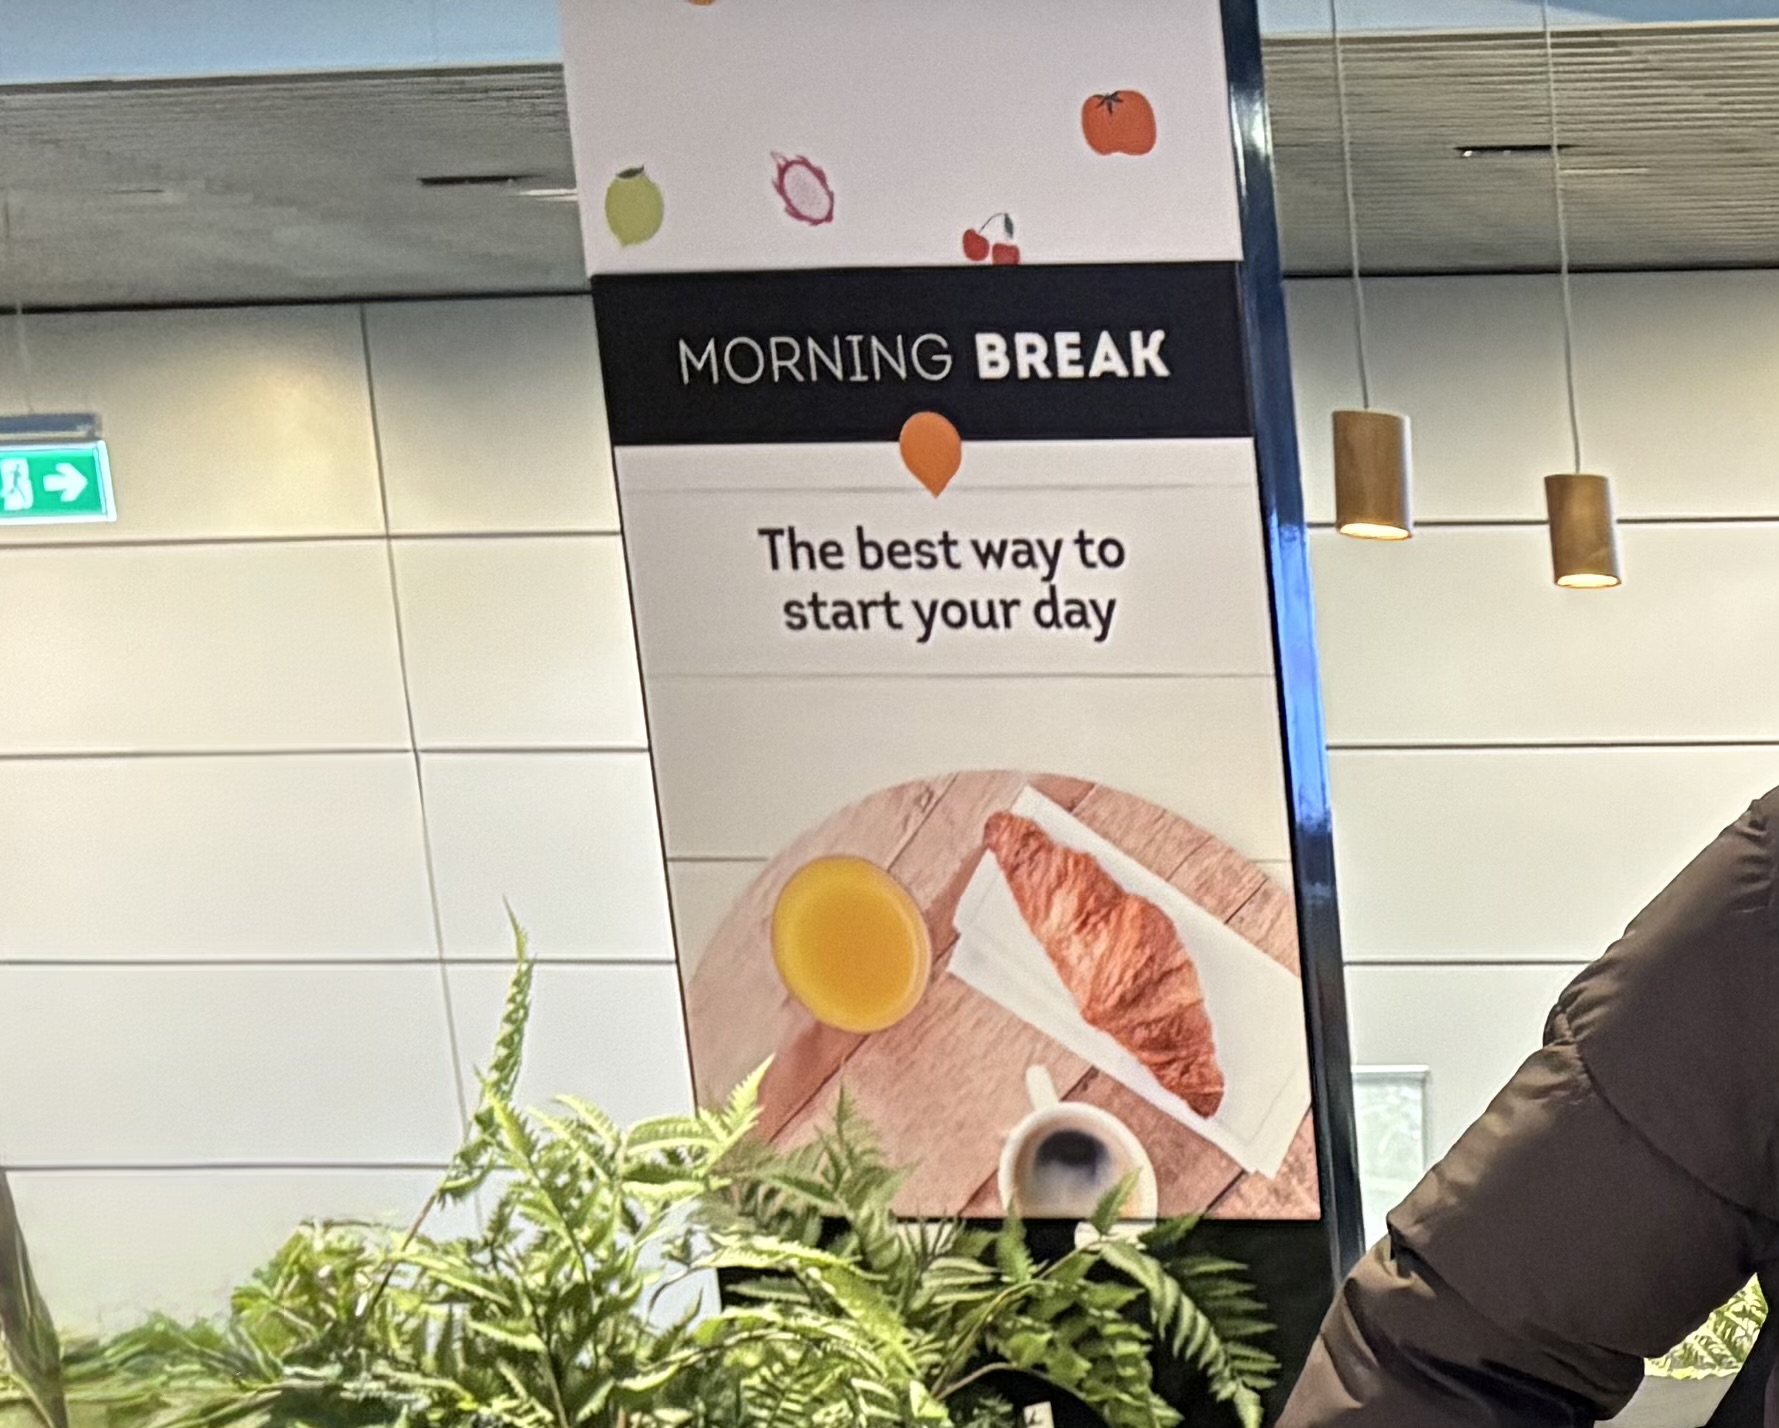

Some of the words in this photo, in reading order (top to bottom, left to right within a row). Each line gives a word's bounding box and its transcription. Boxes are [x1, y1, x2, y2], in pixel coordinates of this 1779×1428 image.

[678, 332, 953, 385] MORNING
[974, 329, 1172, 381] BREAK
[757, 524, 845, 571] The
[856, 524, 962, 571] best
[970, 537, 1064, 583] way
[1073, 528, 1126, 569] to
[783, 591, 904, 631] start
[911, 598, 1022, 644] your
[1033, 583, 1117, 643] day
